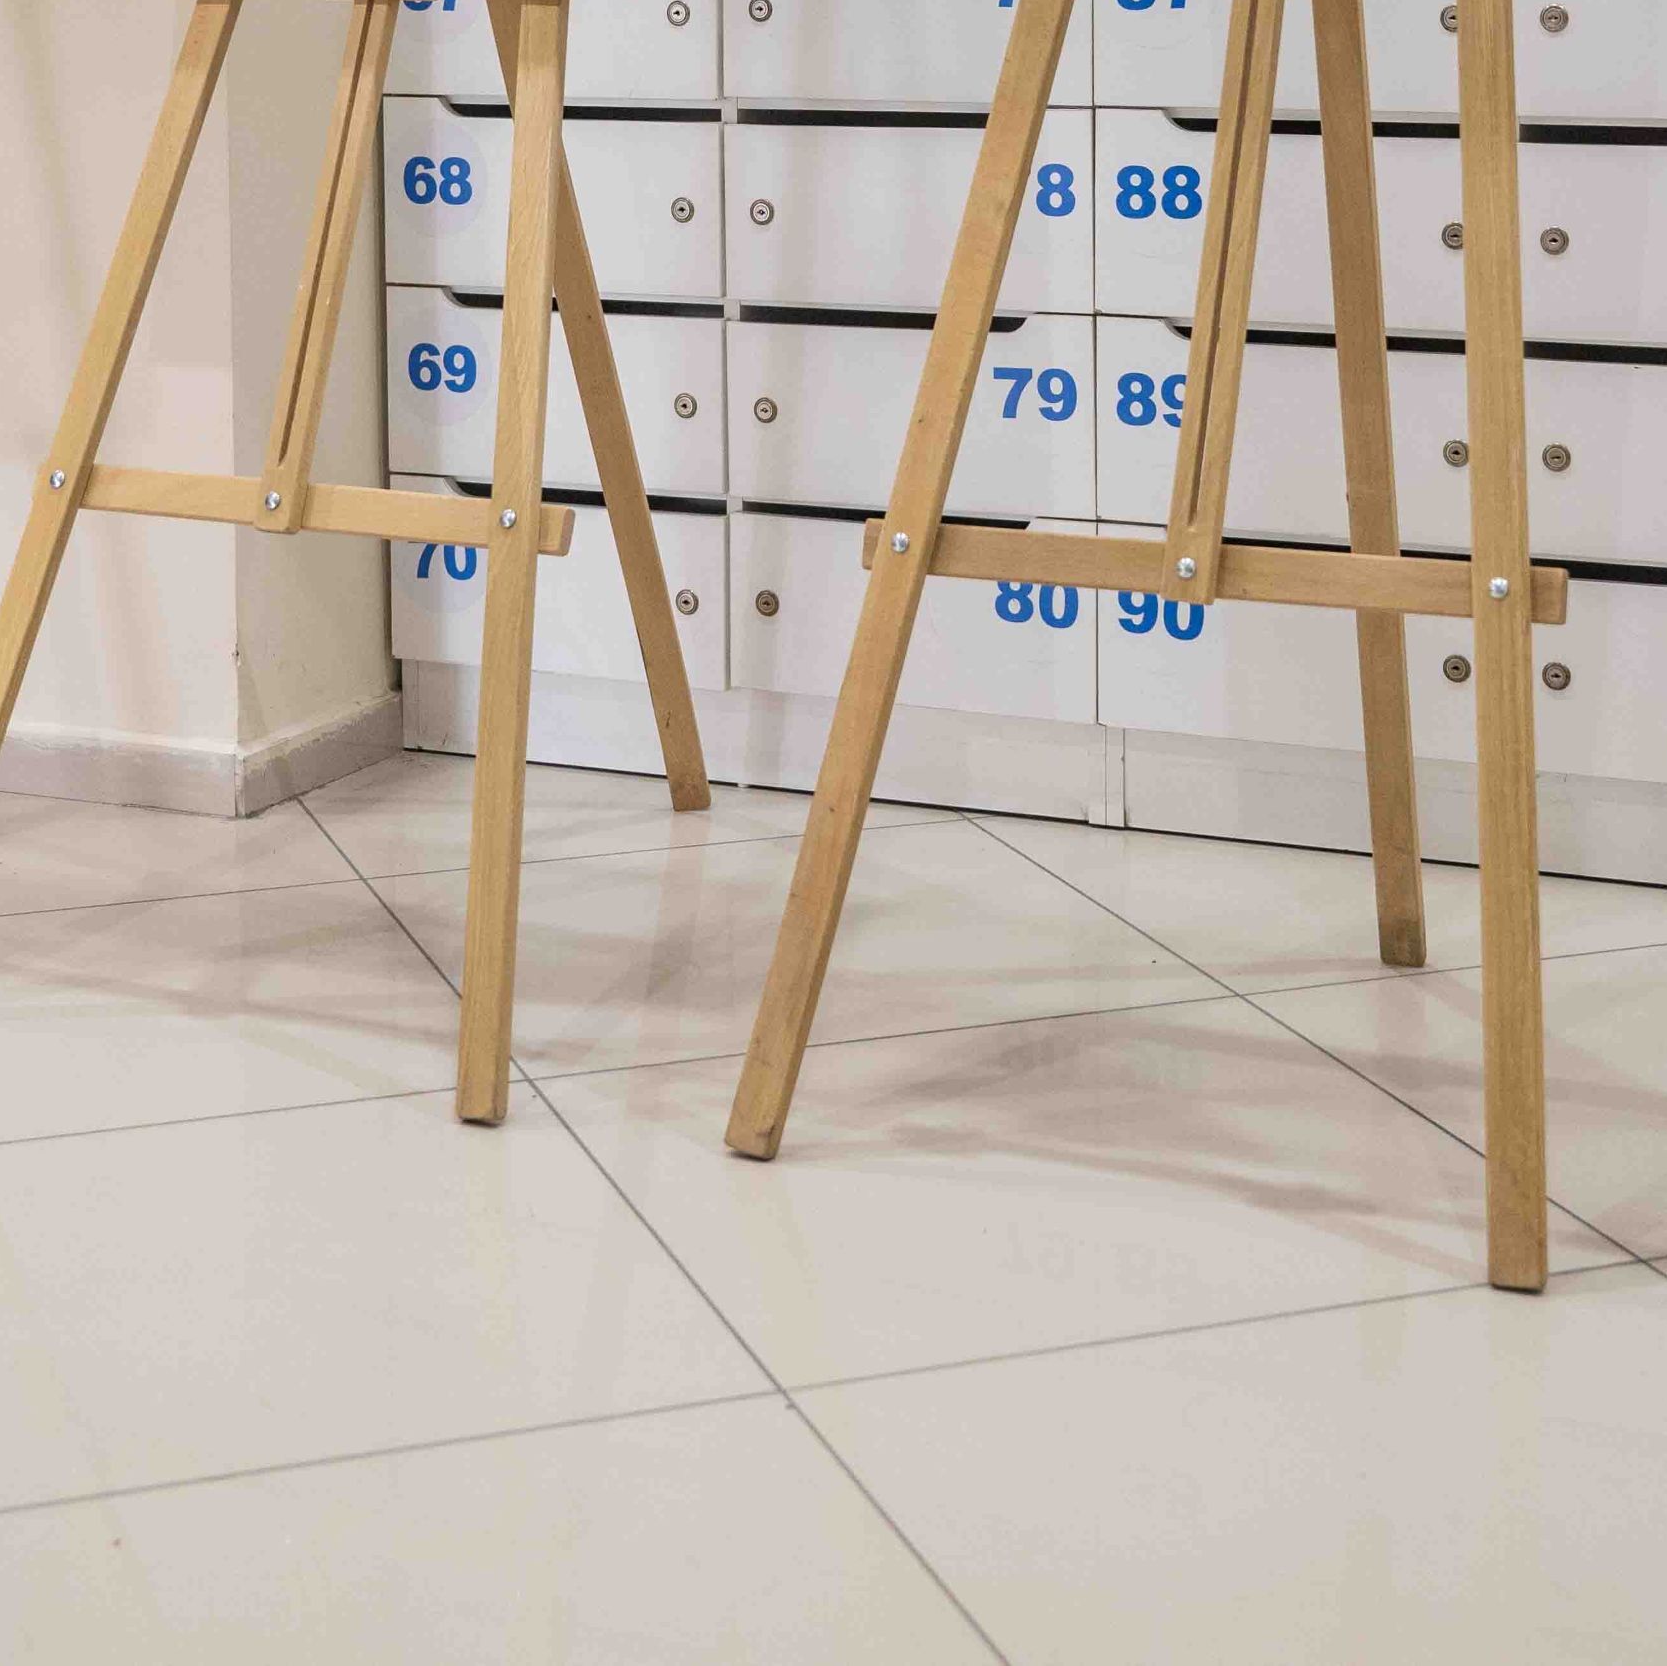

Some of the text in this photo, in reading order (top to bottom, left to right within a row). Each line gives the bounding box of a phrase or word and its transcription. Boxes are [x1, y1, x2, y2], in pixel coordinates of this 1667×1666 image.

[403, 156, 472, 205] 68
[1036, 163, 1076, 217] 8
[1116, 165, 1203, 220] 88
[407, 343, 477, 393] 69
[993, 367, 1077, 421] 79
[1116, 372, 1187, 427] 89
[995, 581, 1080, 629] 80
[1117, 591, 1205, 641] 90
